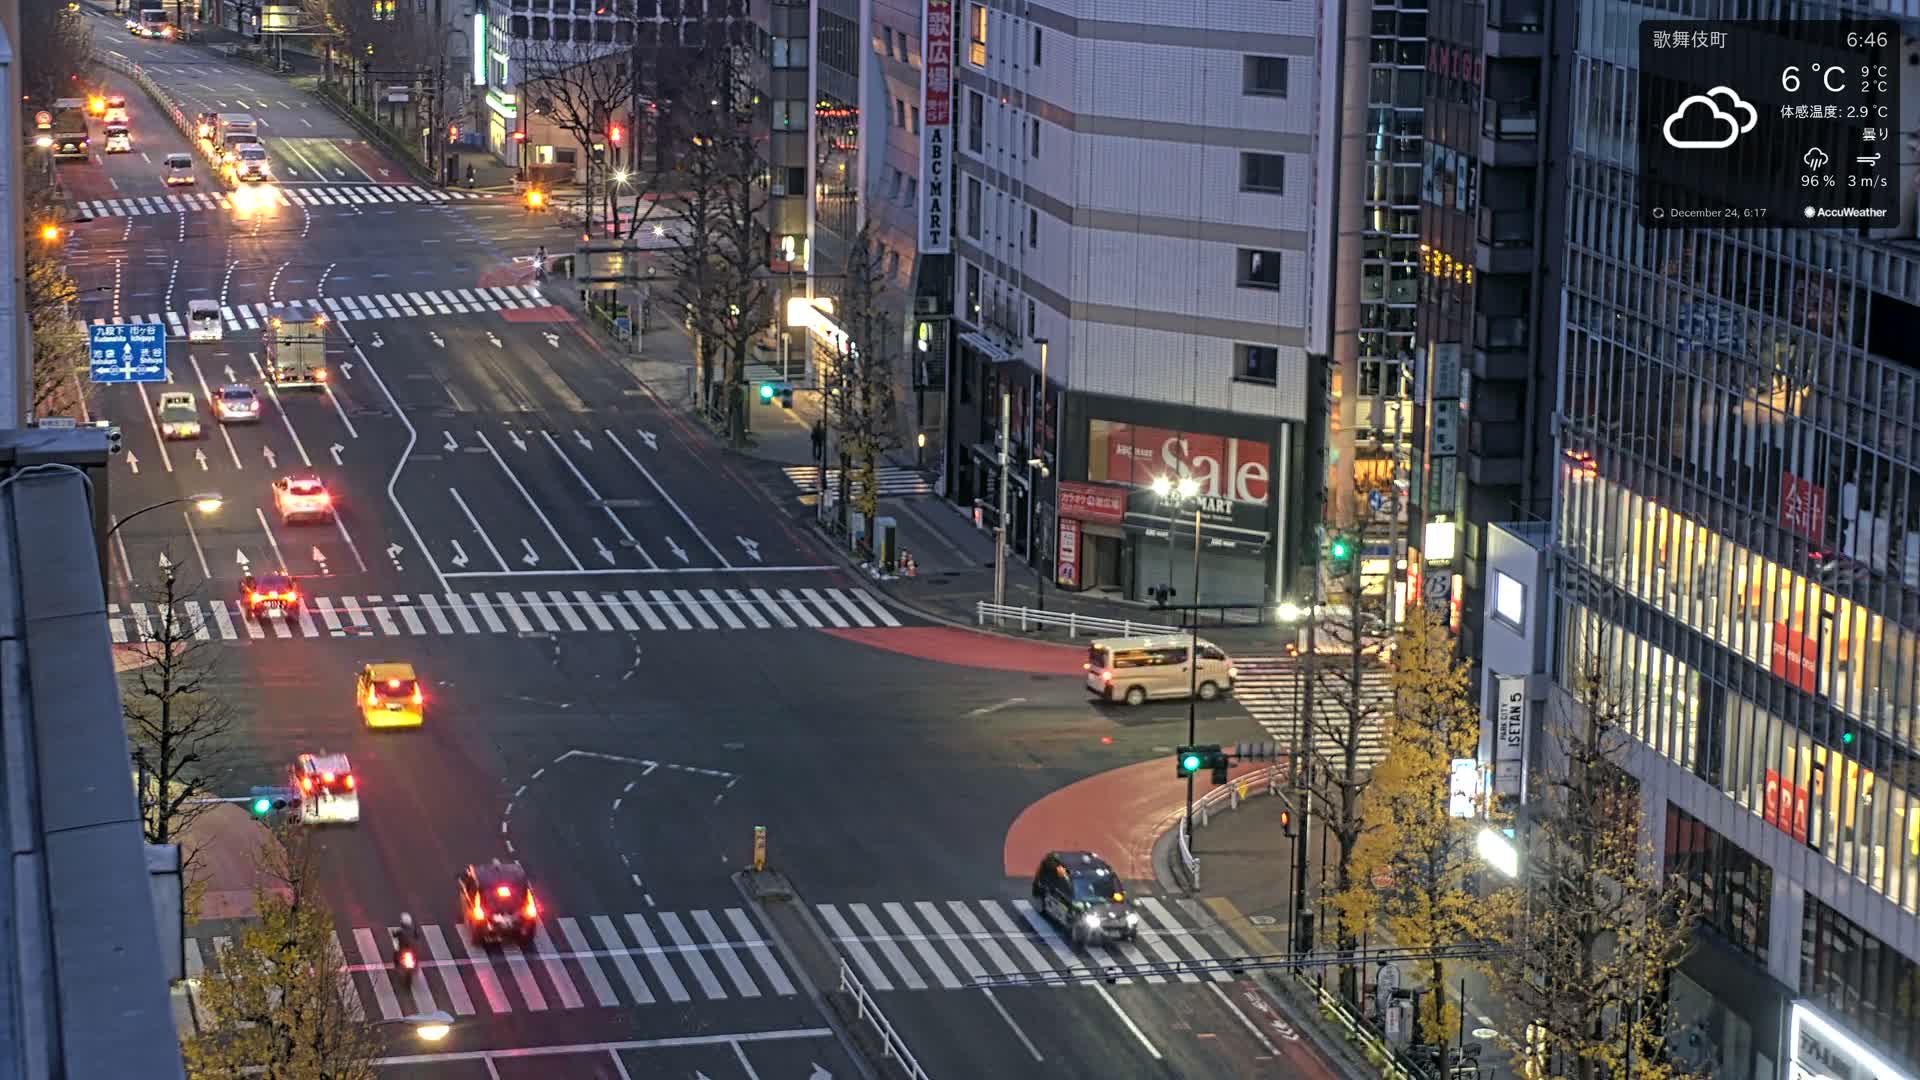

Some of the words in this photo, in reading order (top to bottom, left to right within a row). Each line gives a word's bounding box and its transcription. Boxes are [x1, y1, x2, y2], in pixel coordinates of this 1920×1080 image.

[928, 12, 949, 92] 歌広場
[1162, 437, 1269, 506] Sale
[1500, 703, 1508, 721] CITY
[1510, 692, 1522, 702] 5
[1500, 722, 1508, 741] PARK
[1508, 706, 1521, 747] ISETAN
[1767, 780, 1806, 831] CPA
